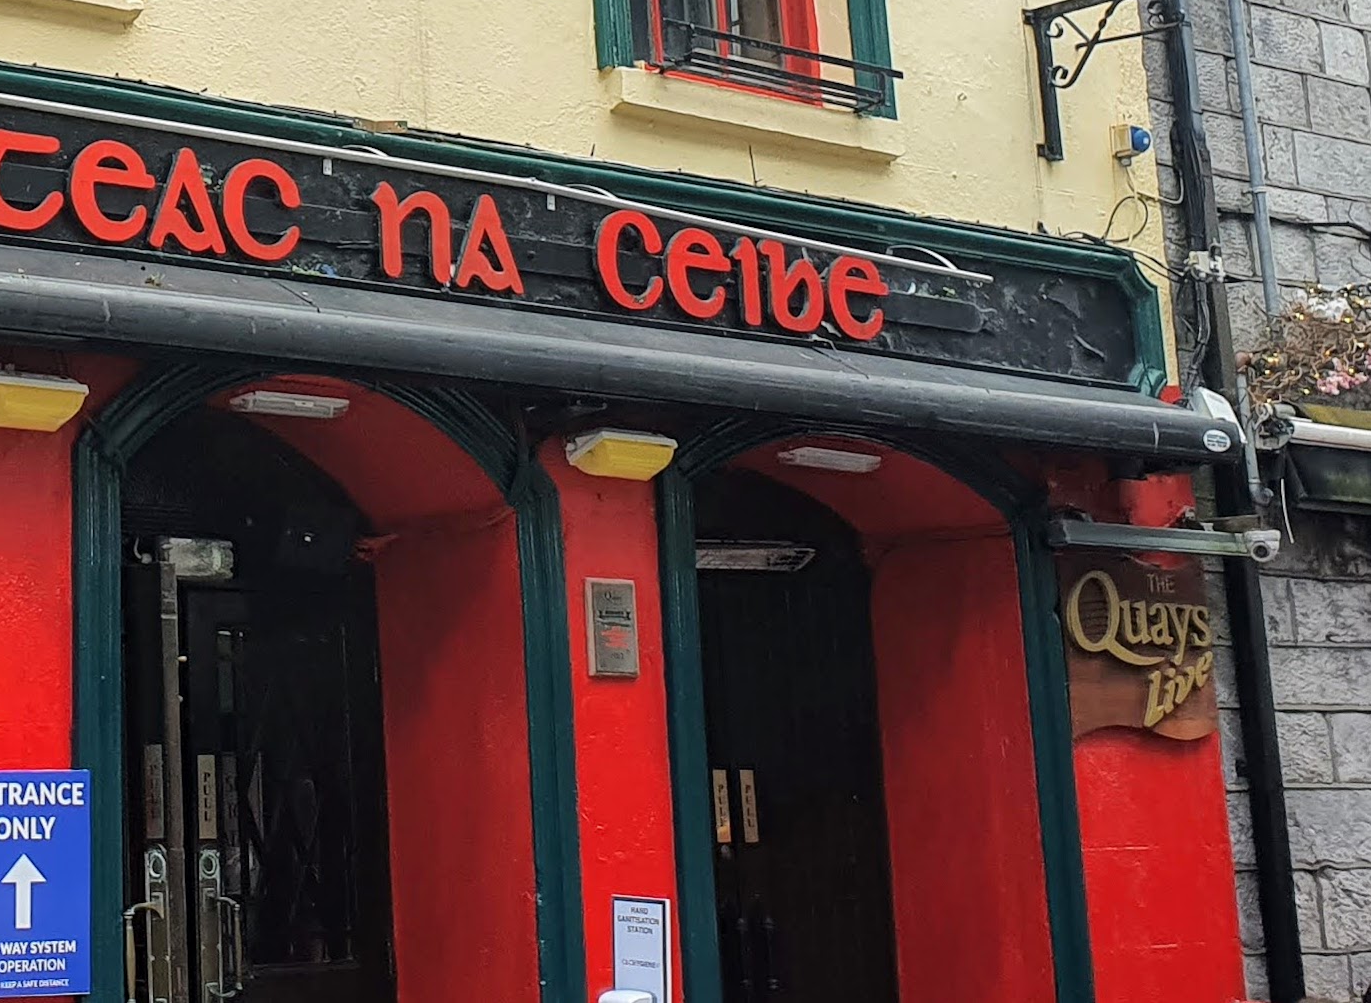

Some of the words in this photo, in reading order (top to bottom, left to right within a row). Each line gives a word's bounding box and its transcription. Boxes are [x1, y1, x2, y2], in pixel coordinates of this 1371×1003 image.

[1146, 573, 1176, 594] THE
[1066, 570, 1213, 666] Quays
[1143, 650, 1214, 728] Live
[202, 771, 212, 823] PULL
[630, 906, 649, 916] HAND
[626, 925, 654, 935] STATION
[0, 942, 29, 955] WAY
[29, 939, 77, 955] SYSTEM
[0, 981, 16, 990] KEEP
[22, 979, 39, 988] SAFE
[39, 978, 70, 988] DISTANCE
